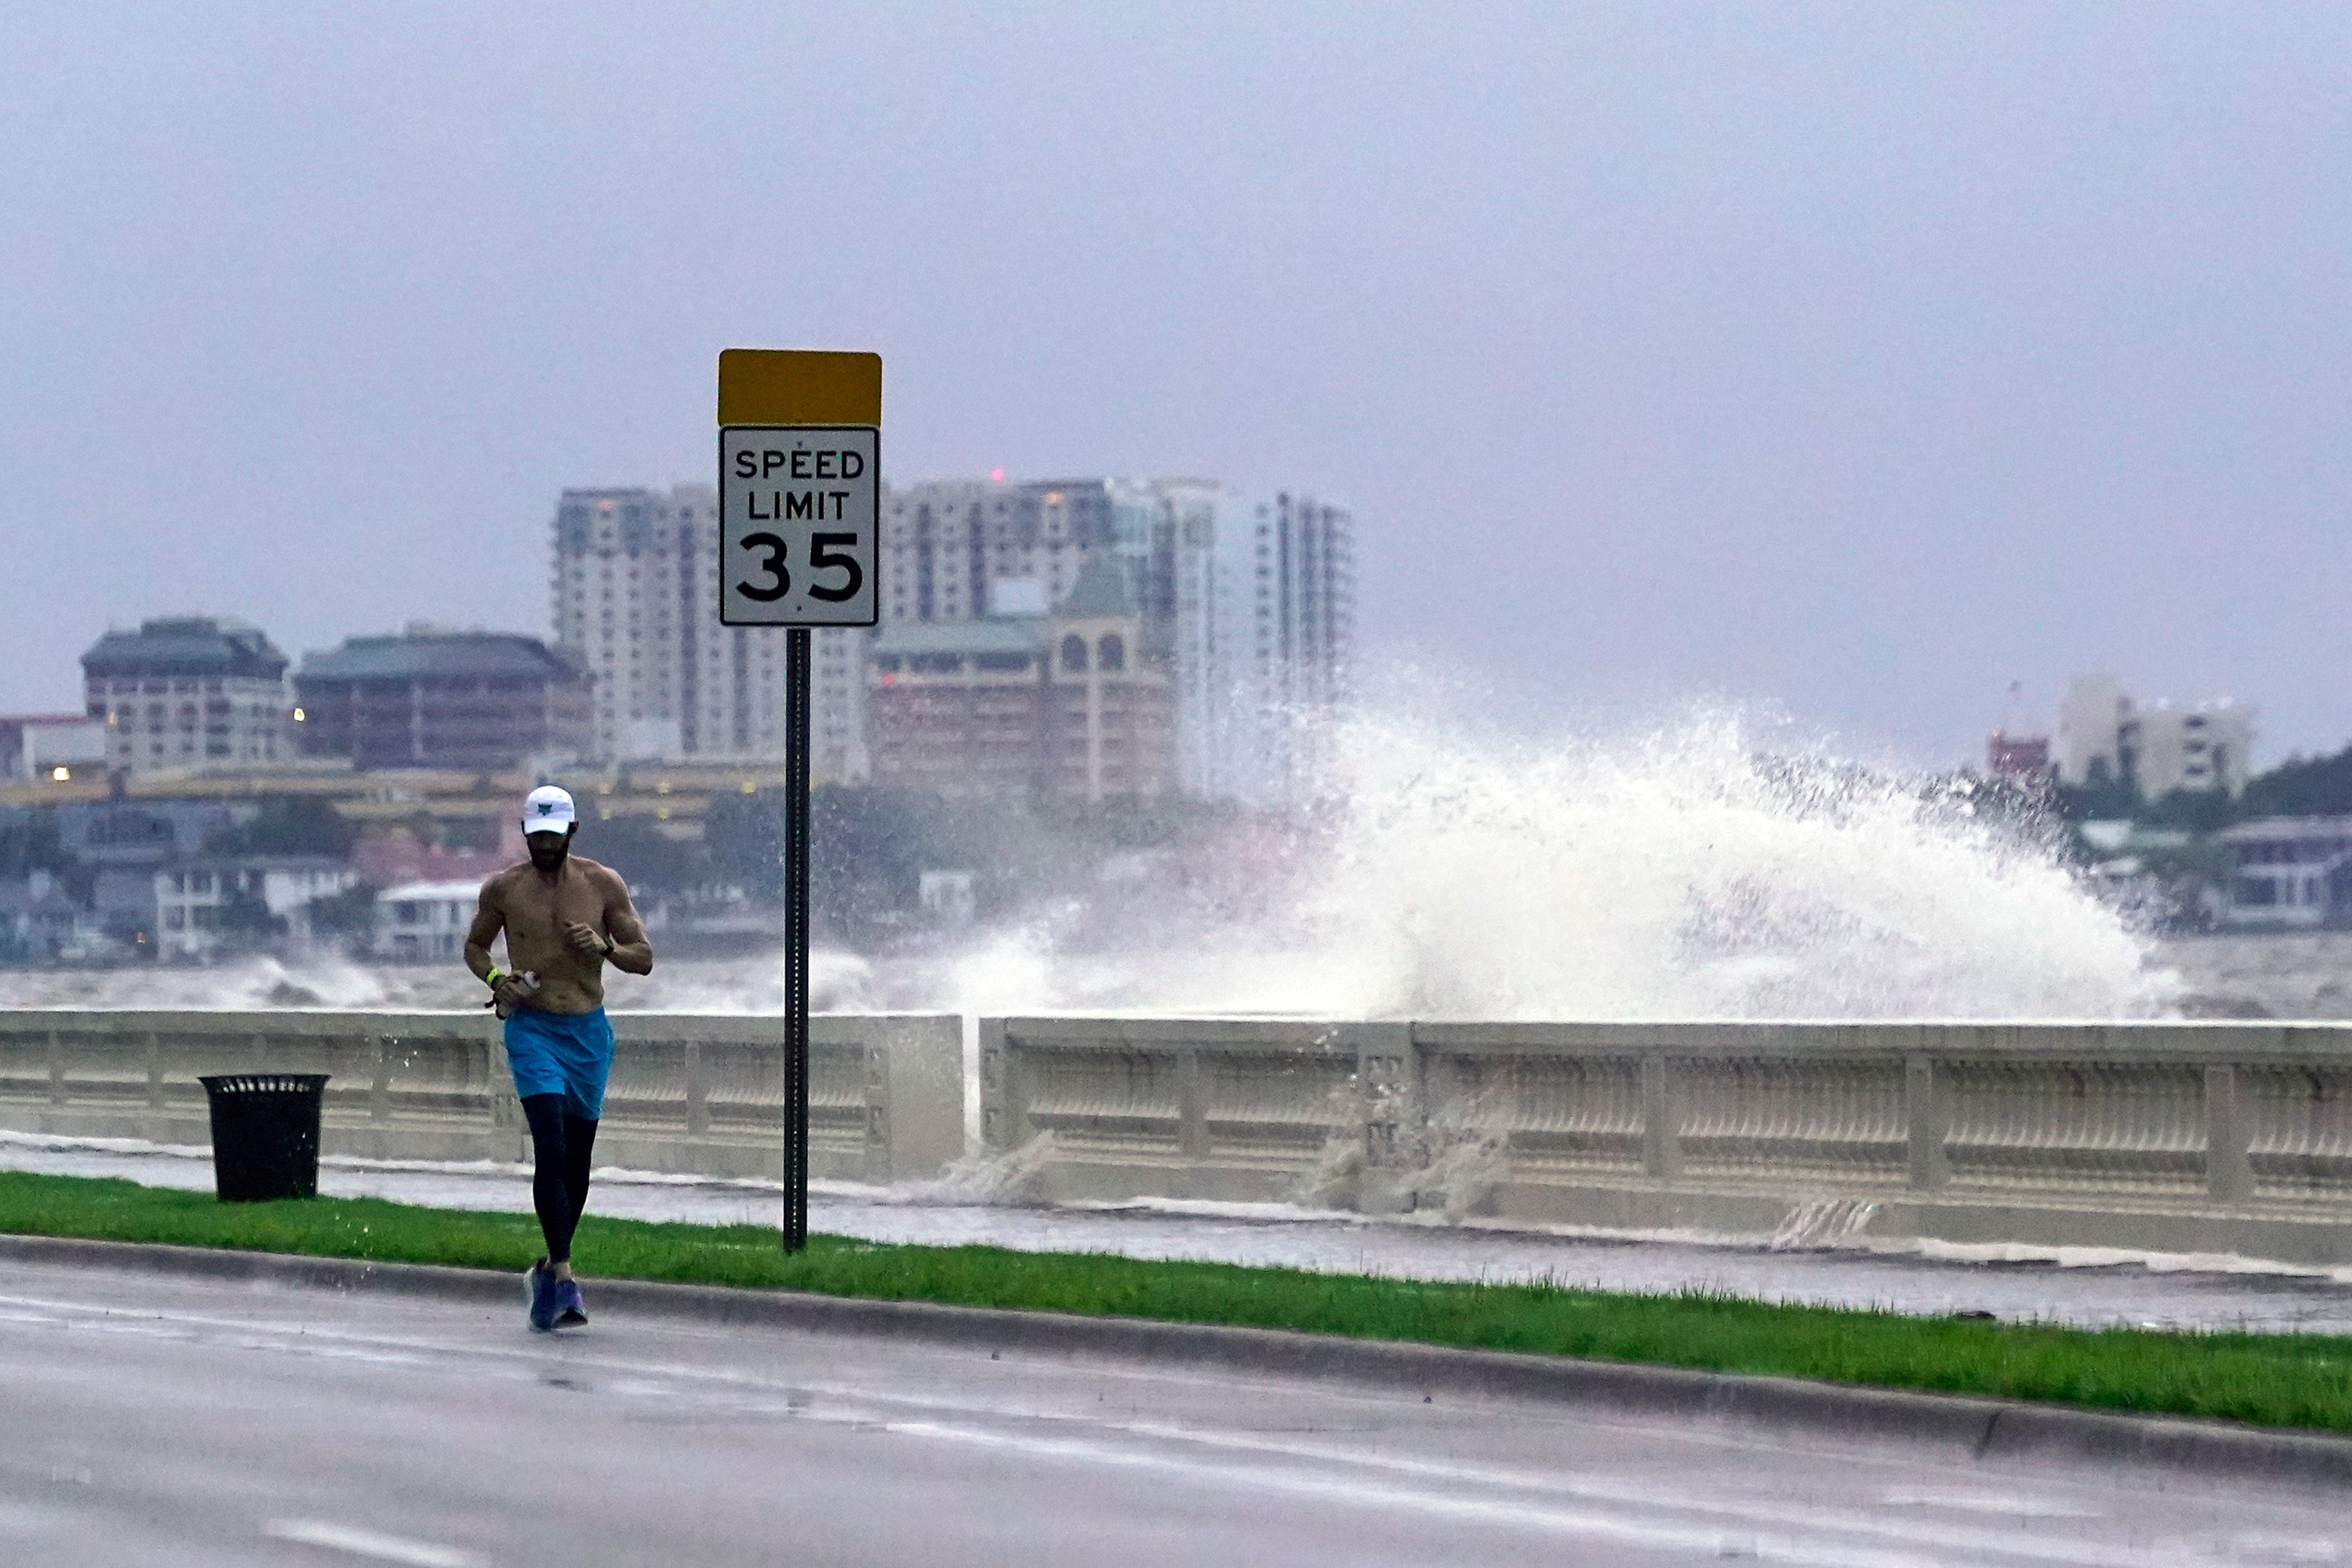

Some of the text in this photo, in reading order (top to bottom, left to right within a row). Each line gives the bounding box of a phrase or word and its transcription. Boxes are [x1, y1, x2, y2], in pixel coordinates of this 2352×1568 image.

[735, 450, 864, 479] SPEED
[748, 491, 850, 520] LIMIT
[735, 532, 863, 603] 35
